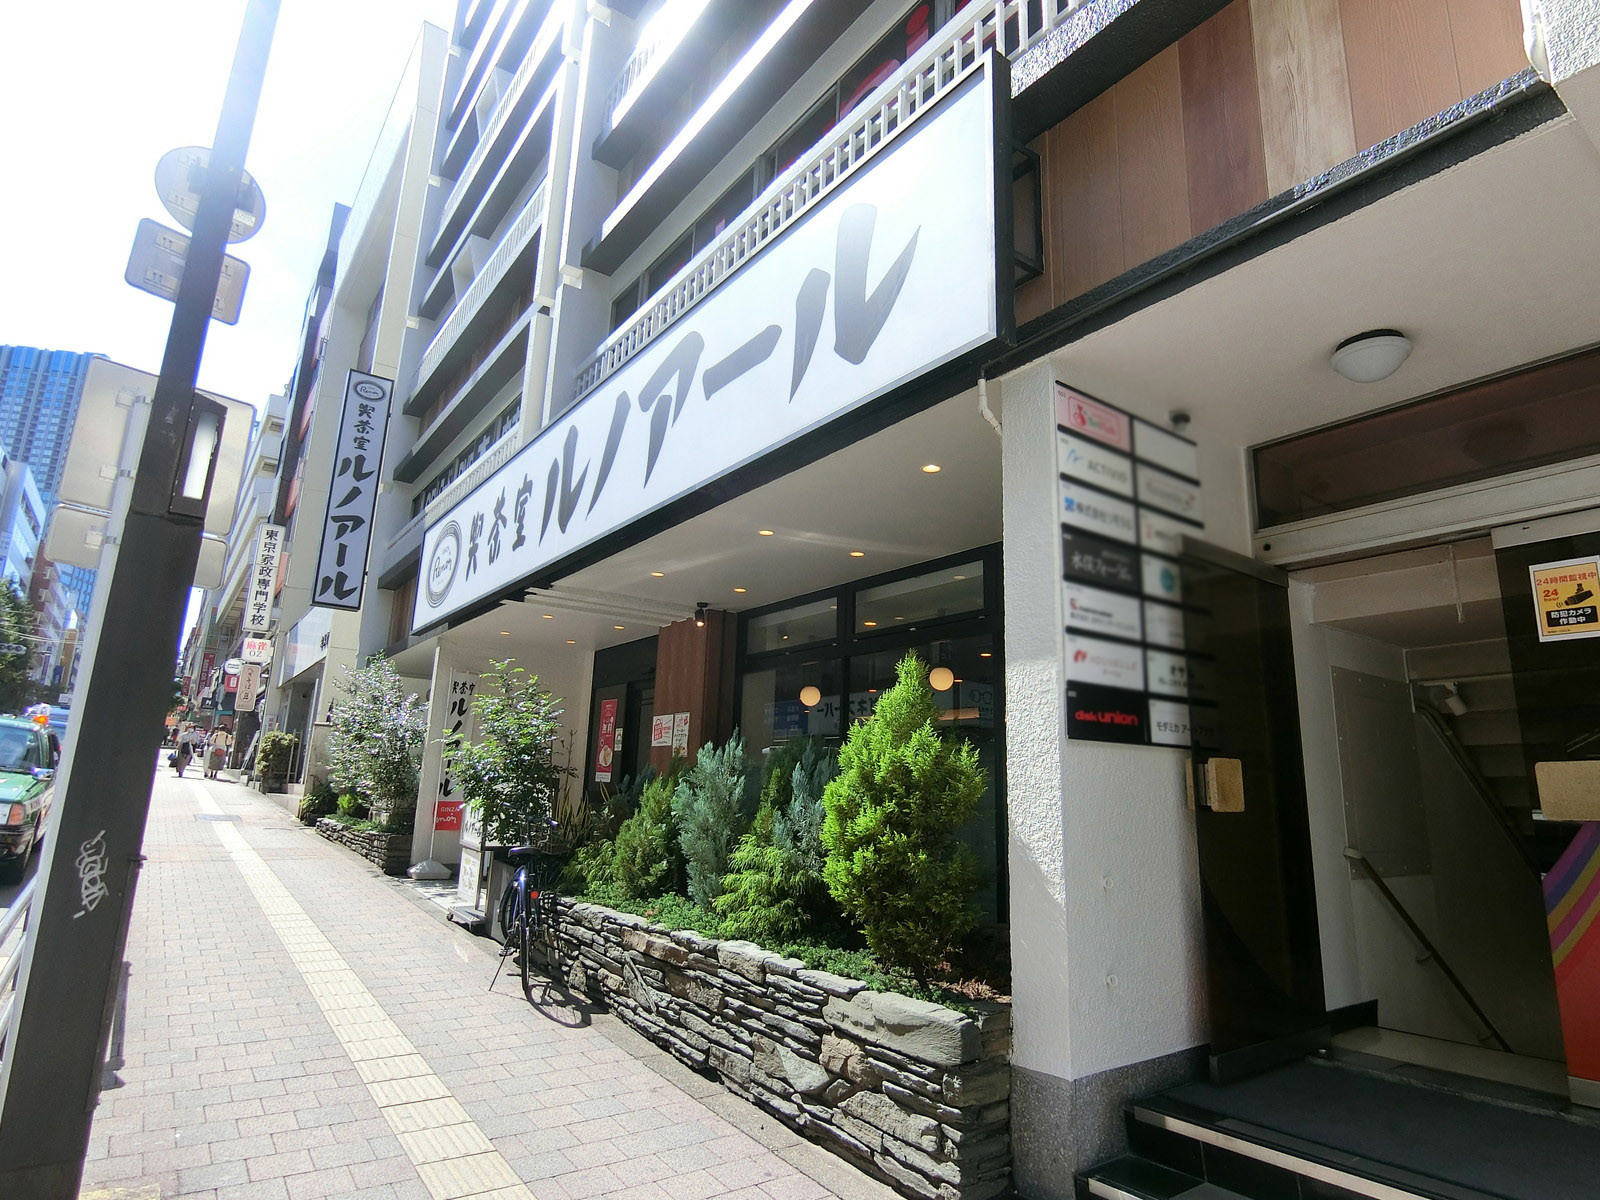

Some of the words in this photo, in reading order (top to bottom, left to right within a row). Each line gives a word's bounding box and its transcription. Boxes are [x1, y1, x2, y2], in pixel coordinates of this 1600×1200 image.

[250, 529, 280, 626] 東京家政専門学校
[1536, 571, 1597, 586] 24時間監視中
[1543, 589, 1559, 598] 24
[1551, 608, 1592, 619] 防犯カメラ
[1560, 616, 1586, 625] 作動中
[1098, 710, 1139, 726] union
